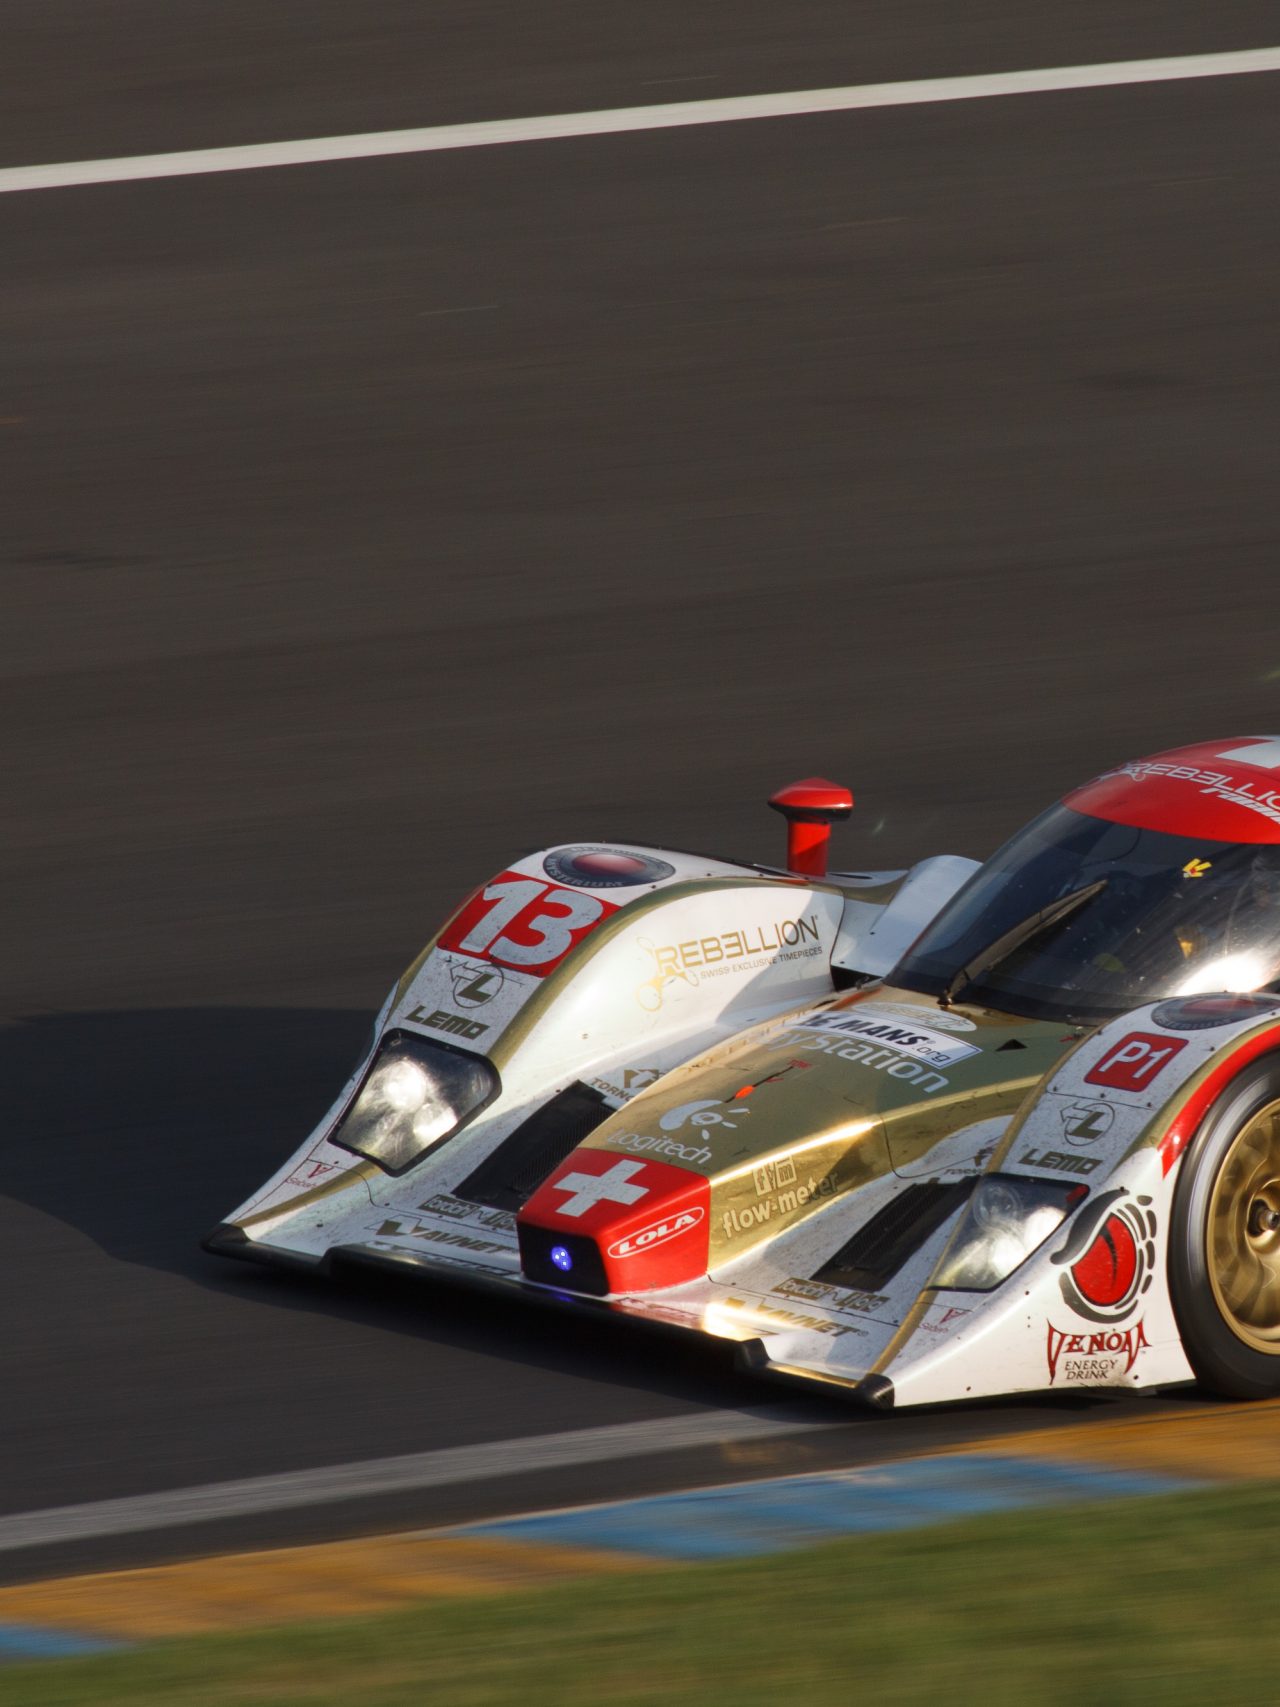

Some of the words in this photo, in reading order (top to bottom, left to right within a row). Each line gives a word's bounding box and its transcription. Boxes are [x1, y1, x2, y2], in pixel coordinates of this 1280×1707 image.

[458, 879, 604, 965] 13
[654, 914, 820, 974] REBELLION
[732, 956, 777, 974] EXCLUSIVE
[778, 946, 823, 964] TIMEPIECES
[406, 1005, 490, 1040] LEMO
[831, 1014, 930, 1047] MANS
[1099, 1041, 1172, 1079] P1
[607, 1128, 713, 1165] Logitech
[1018, 1148, 1104, 1176] LEMO
[722, 1171, 839, 1239] flow-meter
[619, 1213, 697, 1255] LOLA
[772, 1309, 859, 1338] AVNET
[1046, 1313, 1152, 1386] VENOM
[1064, 1358, 1118, 1371] ENERGY
[1065, 1369, 1109, 1381] DRINK
